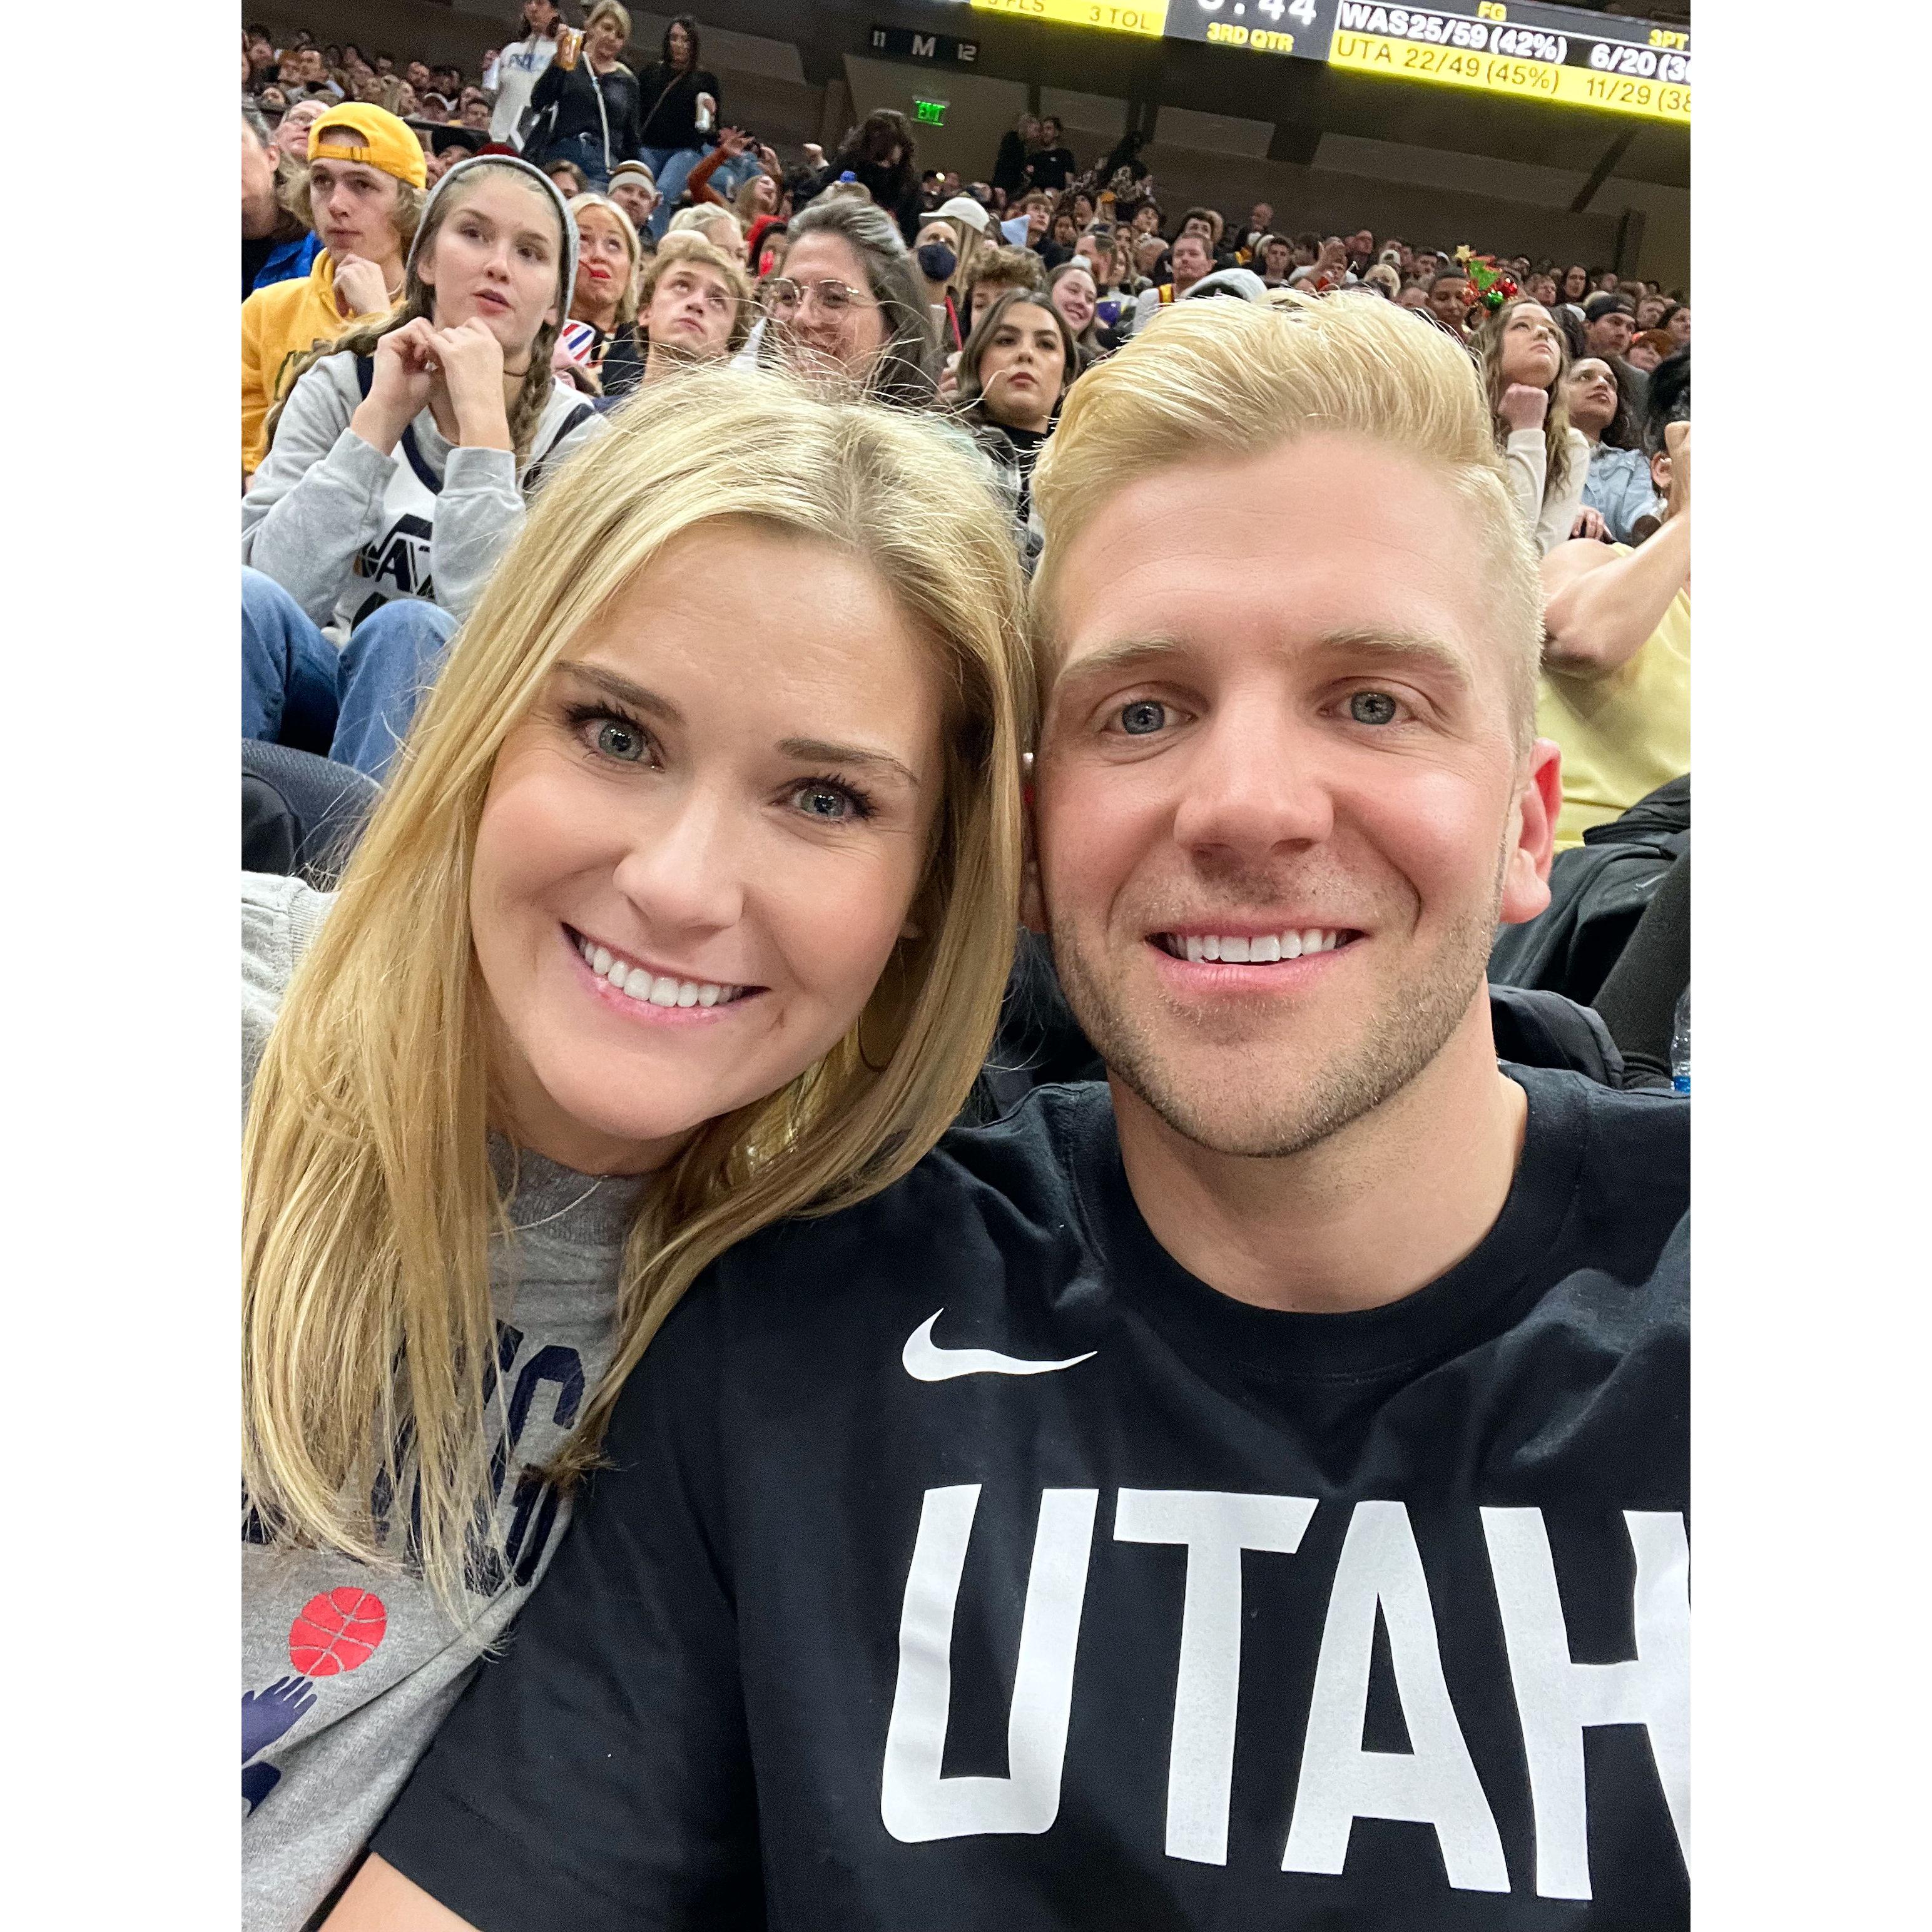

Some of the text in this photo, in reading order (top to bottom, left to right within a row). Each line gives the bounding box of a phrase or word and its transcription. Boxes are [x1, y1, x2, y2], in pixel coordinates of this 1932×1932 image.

[1089, 6, 1101, 22] 3
[1109, 8, 1151, 30] TOL
[1477, 1, 1507, 21] FG
[912, 34, 937, 57] M
[957, 43, 978, 61] 12
[1206, 21, 1294, 52] 3RD QTR
[1489, 26, 1567, 64] (42%)
[1649, 29, 1689, 49] 3PT
[1337, 36, 1560, 94] UTA 22/49 (45%)
[1591, 44, 1657, 76] 6/20
[1587, 77, 1652, 105] 11/29
[880, 1483, 1690, 1901] UTAH
